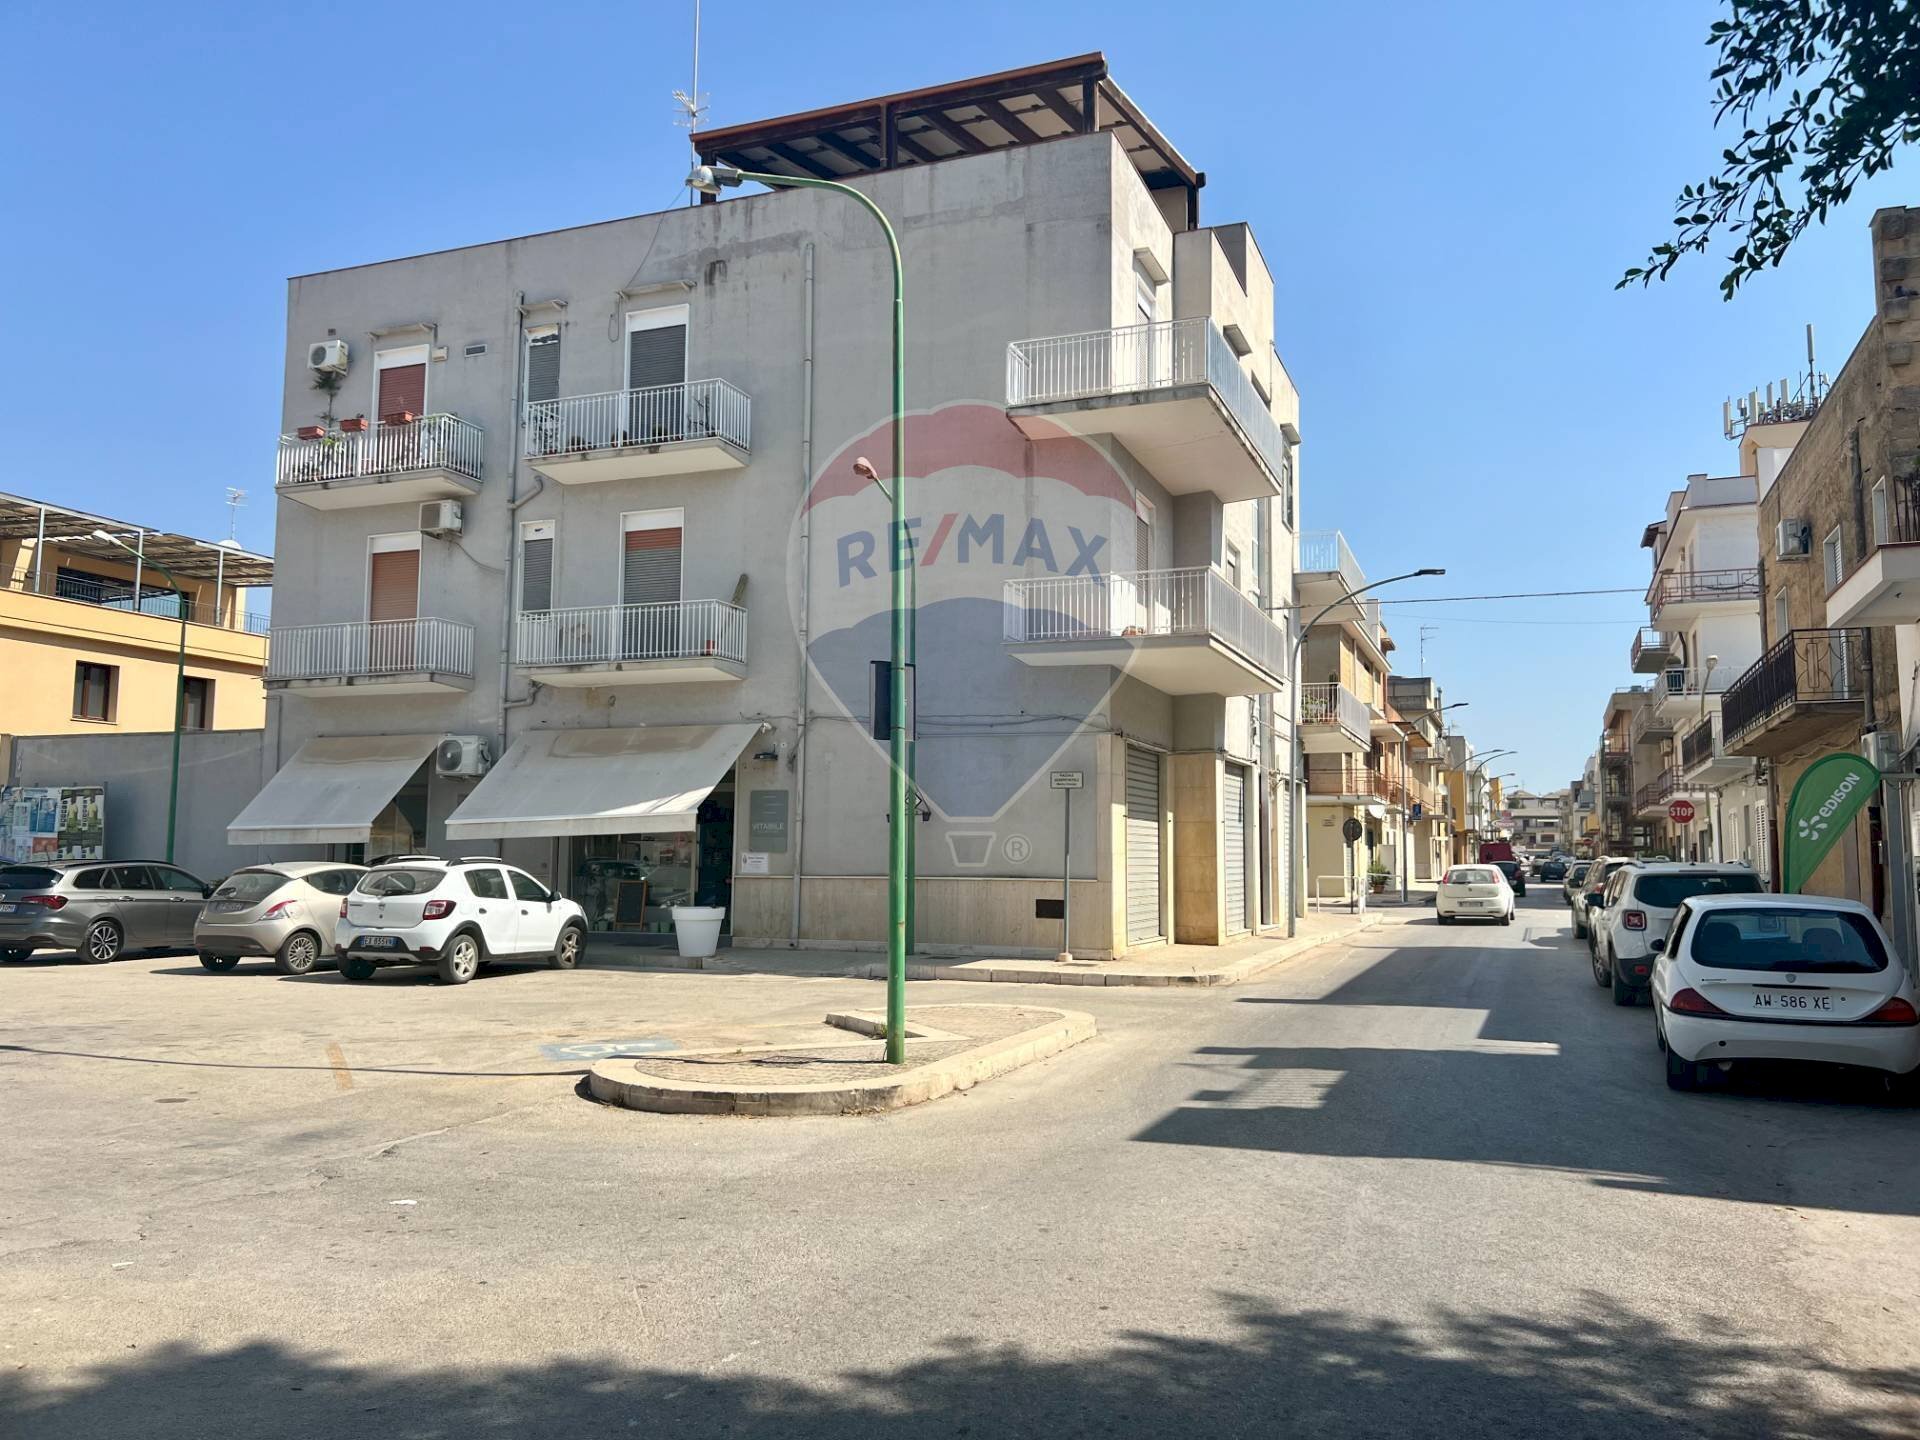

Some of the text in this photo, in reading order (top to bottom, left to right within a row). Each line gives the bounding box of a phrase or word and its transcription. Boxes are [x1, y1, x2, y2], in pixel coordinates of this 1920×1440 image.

[1670, 806, 1694, 817] STOP
[1755, 993, 1831, 1010] AW 586 XE
